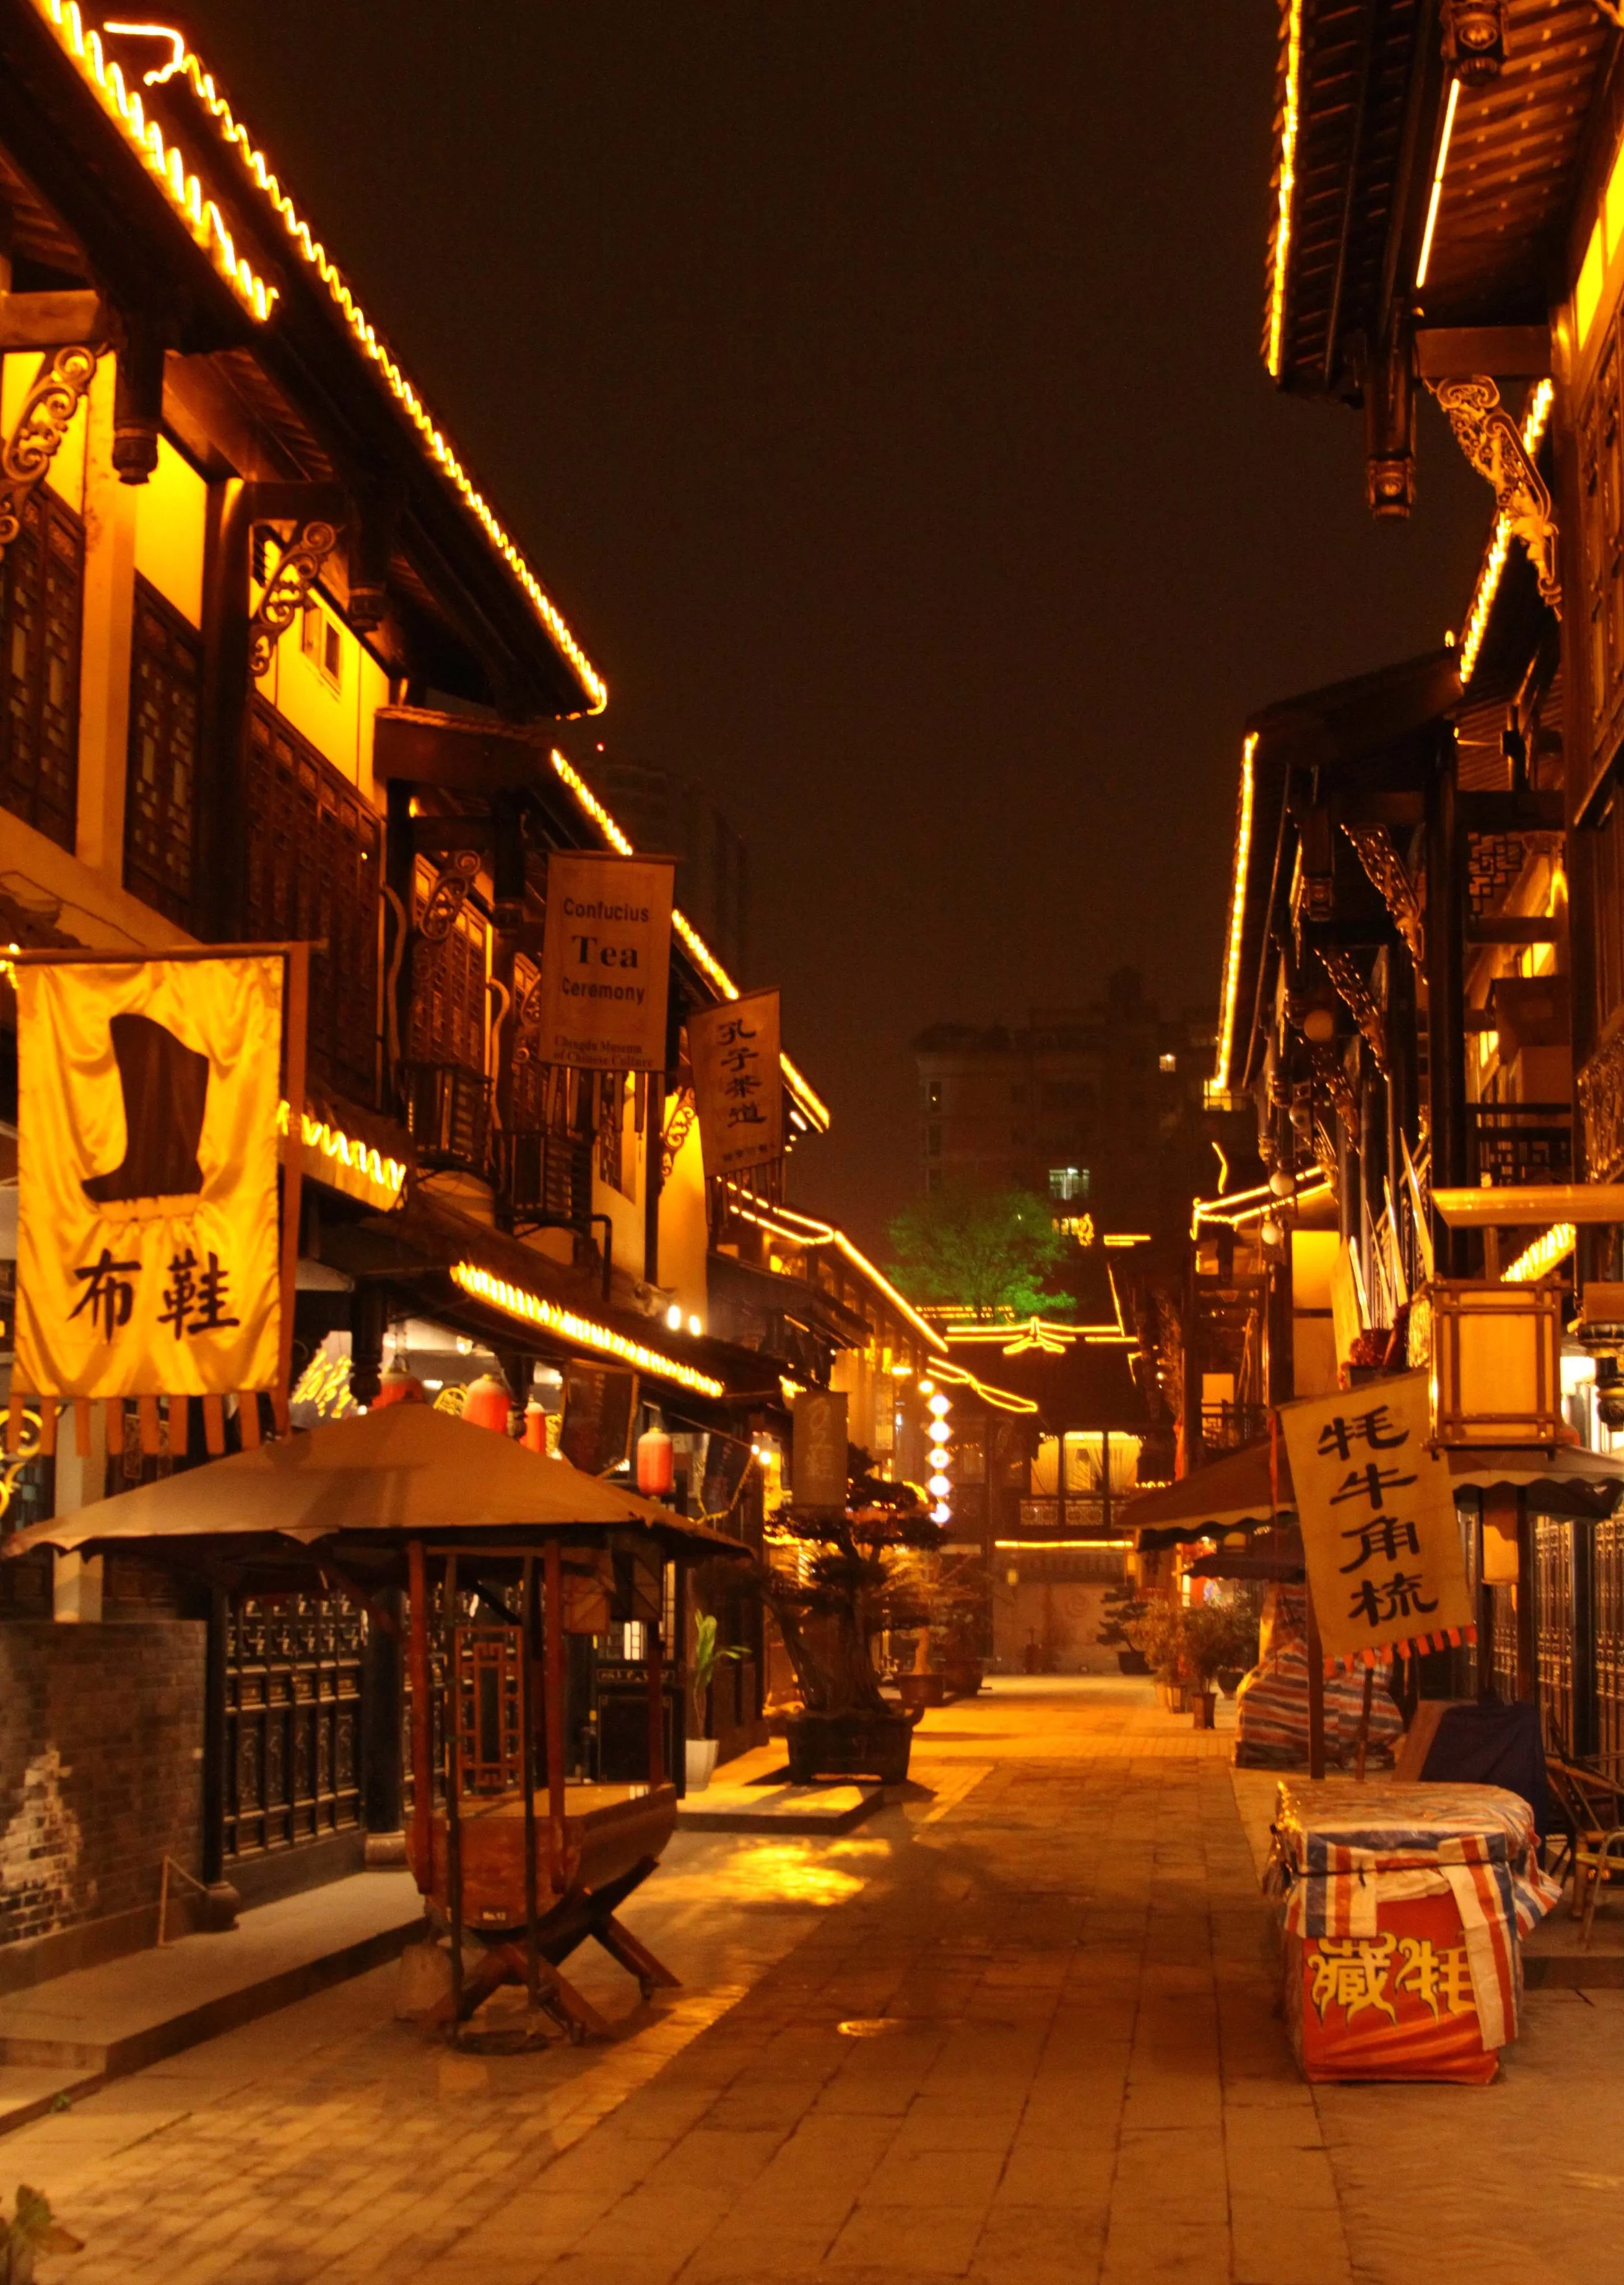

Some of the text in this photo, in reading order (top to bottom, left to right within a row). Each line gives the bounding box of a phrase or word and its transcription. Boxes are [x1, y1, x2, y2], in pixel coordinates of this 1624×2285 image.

[564, 897, 649, 923] Confucius
[572, 934, 638, 968] Tea
[562, 977, 645, 1006] Ceremony
[717, 1018, 768, 1128] 孔子茶道
[67, 1248, 240, 1346] 布鞋
[1317, 1403, 1439, 1628] 牦牛角梳
